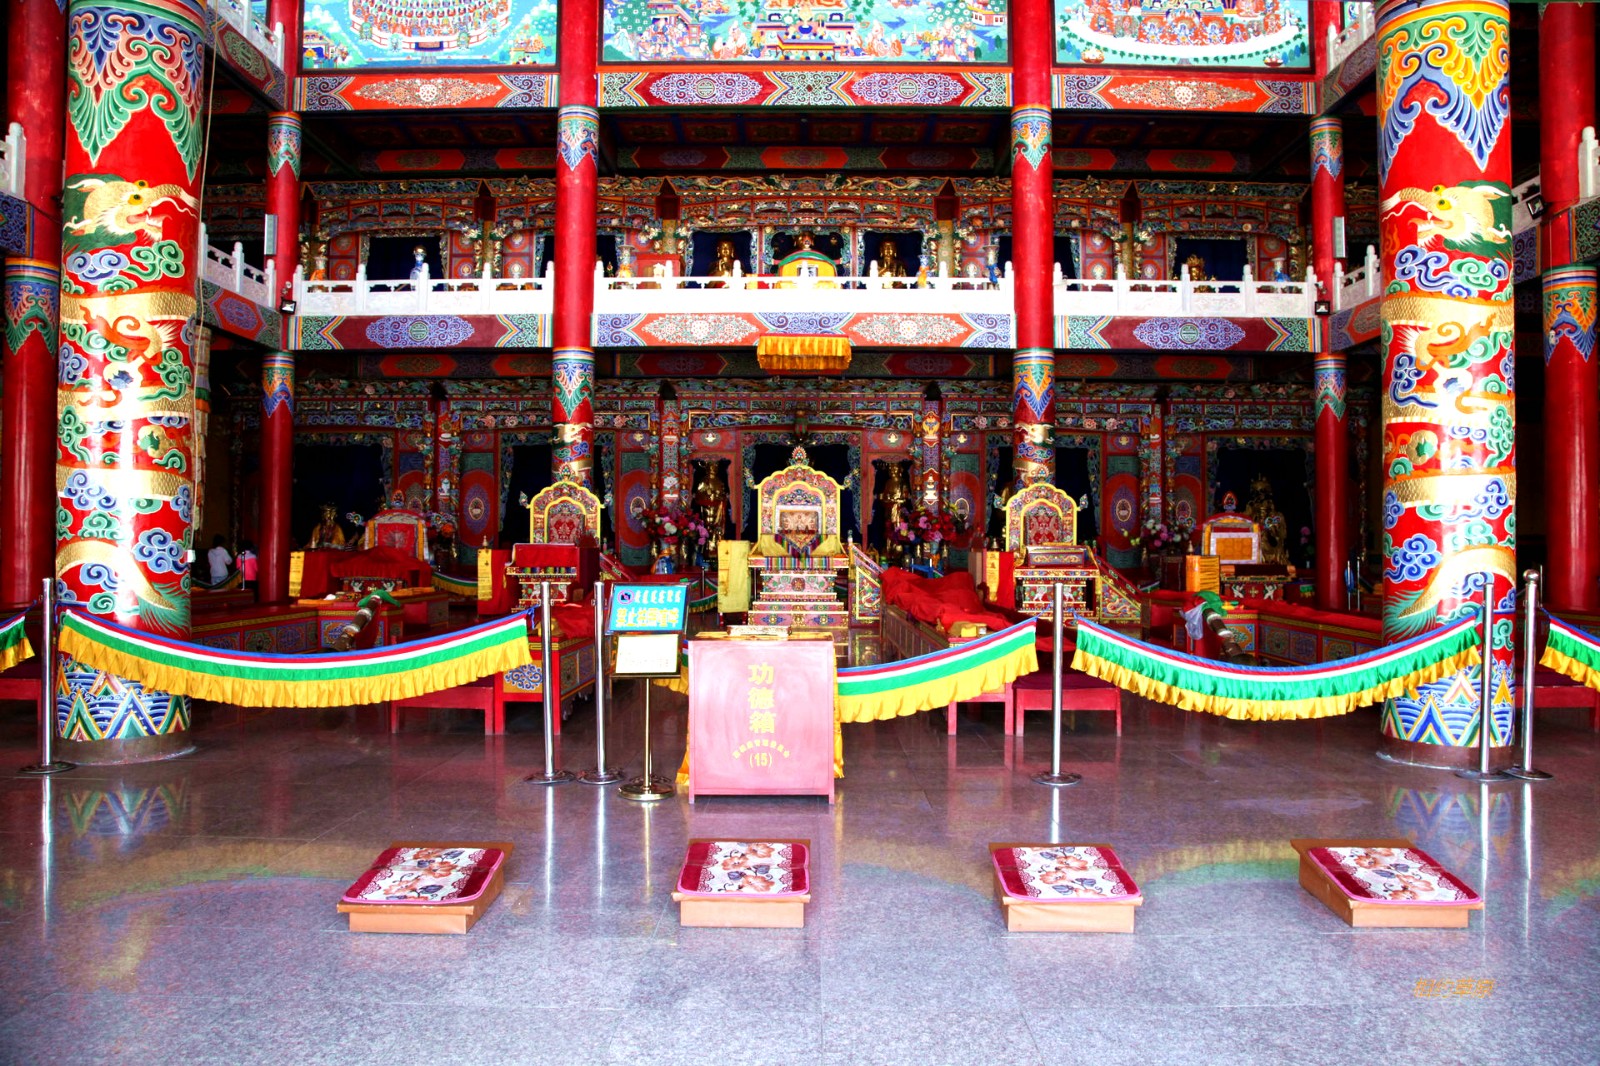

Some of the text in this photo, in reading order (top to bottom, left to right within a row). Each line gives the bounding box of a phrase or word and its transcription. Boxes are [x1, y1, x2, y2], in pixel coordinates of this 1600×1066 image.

[748, 662, 776, 733] 功德箱
[749, 752, 773, 768] (15)
